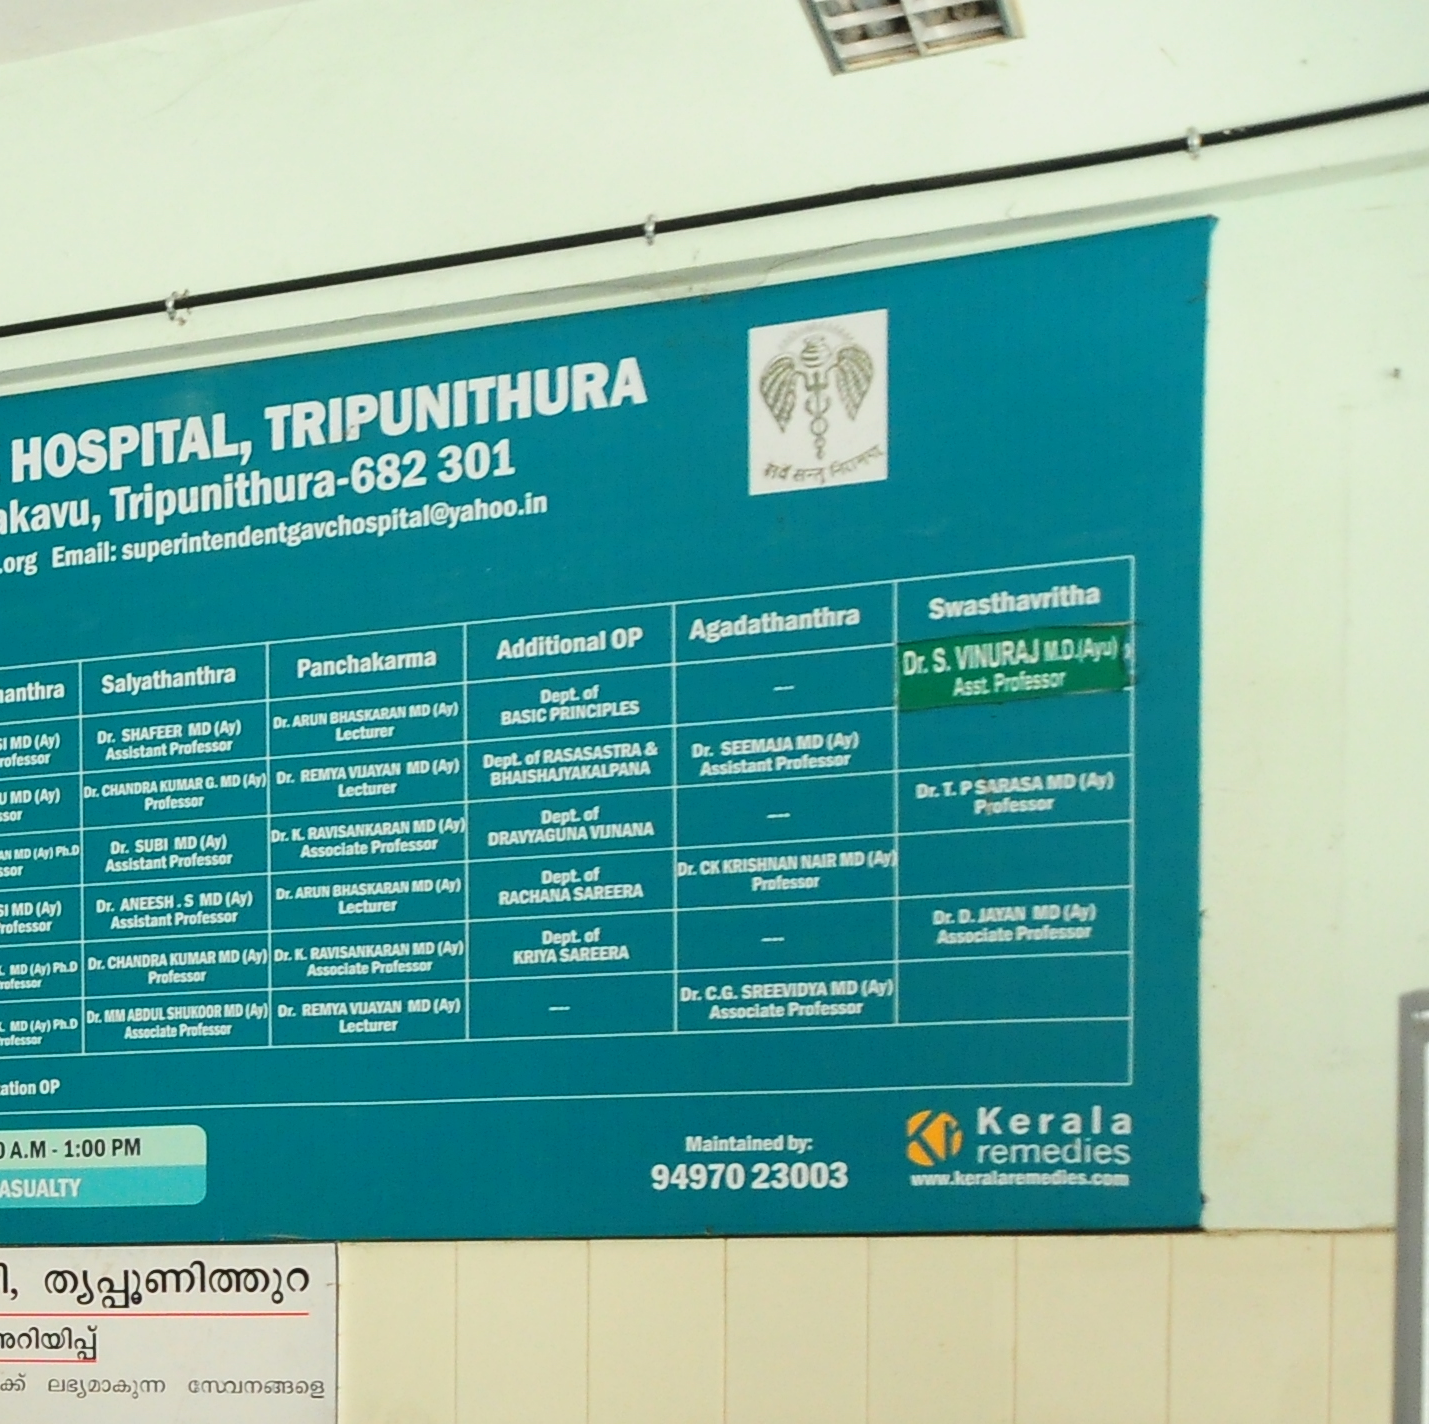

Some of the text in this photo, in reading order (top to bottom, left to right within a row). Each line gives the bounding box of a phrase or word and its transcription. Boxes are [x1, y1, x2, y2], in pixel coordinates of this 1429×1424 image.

[11, 412, 253, 483] HOSPITAL,
[263, 356, 649, 451] TRIPUNITHURA
[109, 449, 428, 526] Tripunithura-682
[437, 438, 516, 484] 301
[51, 540, 117, 569] Email:
[121, 491, 548, 563] superintendentgavchospital@yahoo.in
[928, 584, 1102, 620] Swasthavritha
[688, 606, 861, 644] Agadathanthra
[496, 626, 644, 660] Additional OP
[902, 650, 929, 676] Dr.
[932, 647, 952, 674] S.
[954, 638, 1040, 671] VINURAJ
[296, 650, 437, 679] Panchakarma
[101, 665, 237, 696] Salyathanthra
[953, 670, 1067, 697] Asst. Professor
[9, 734, 33, 752] MD
[33, 732, 61, 751] (Ay)
[38, 1078, 61, 1095] OP
[977, 1105, 1133, 1136] Kerala
[9, 1140, 46, 1160] A.M
[64, 1138, 106, 1158] 1:00
[111, 1137, 141, 1157] PM
[685, 1134, 813, 1155] Maintained by:
[977, 1137, 1132, 1165] remedies
[650, 1161, 849, 1191] 94970 23003
[910, 1169, 1130, 1187] www.keralaremedies.com
